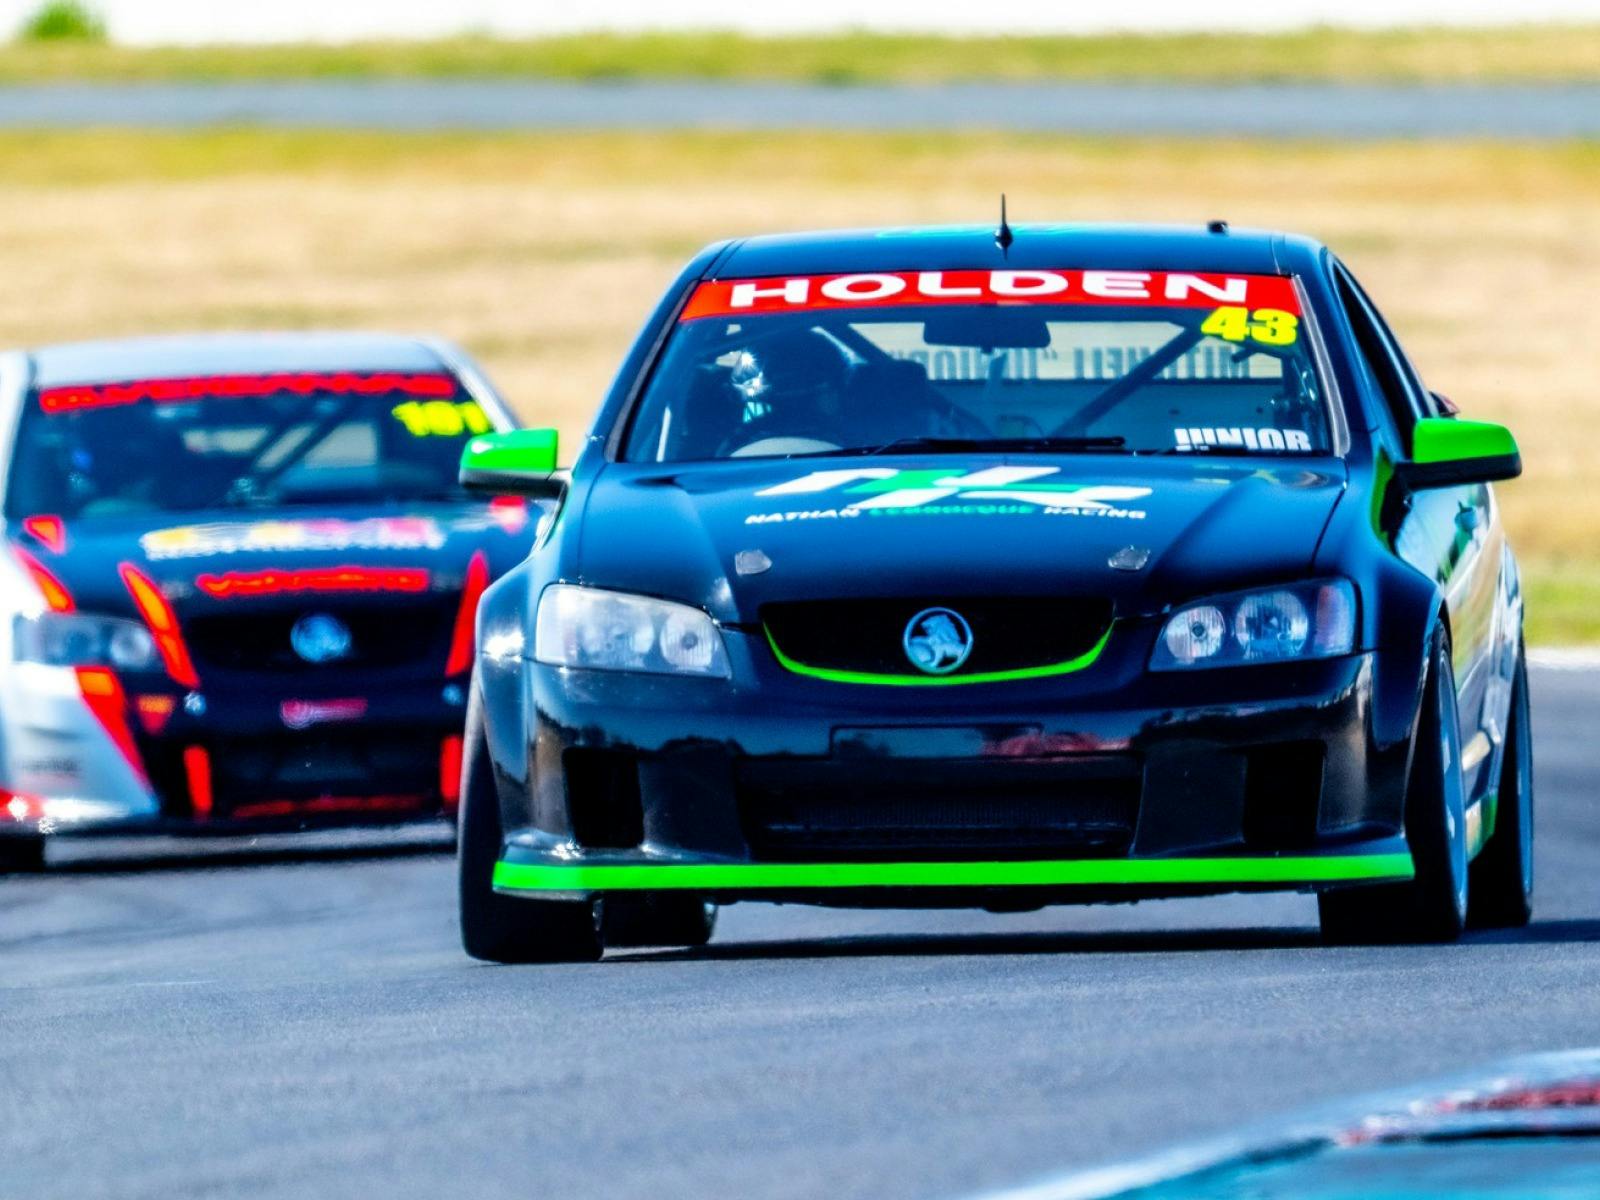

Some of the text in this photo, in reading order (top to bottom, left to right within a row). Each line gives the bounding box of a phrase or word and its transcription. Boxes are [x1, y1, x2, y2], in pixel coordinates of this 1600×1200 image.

[730, 270, 1249, 307] HOLDEN
[1201, 306, 1298, 346] 43
[1174, 428, 1312, 452] JUNIOR
[744, 507, 860, 525] NATHAN
[1043, 505, 1147, 520] RACING
